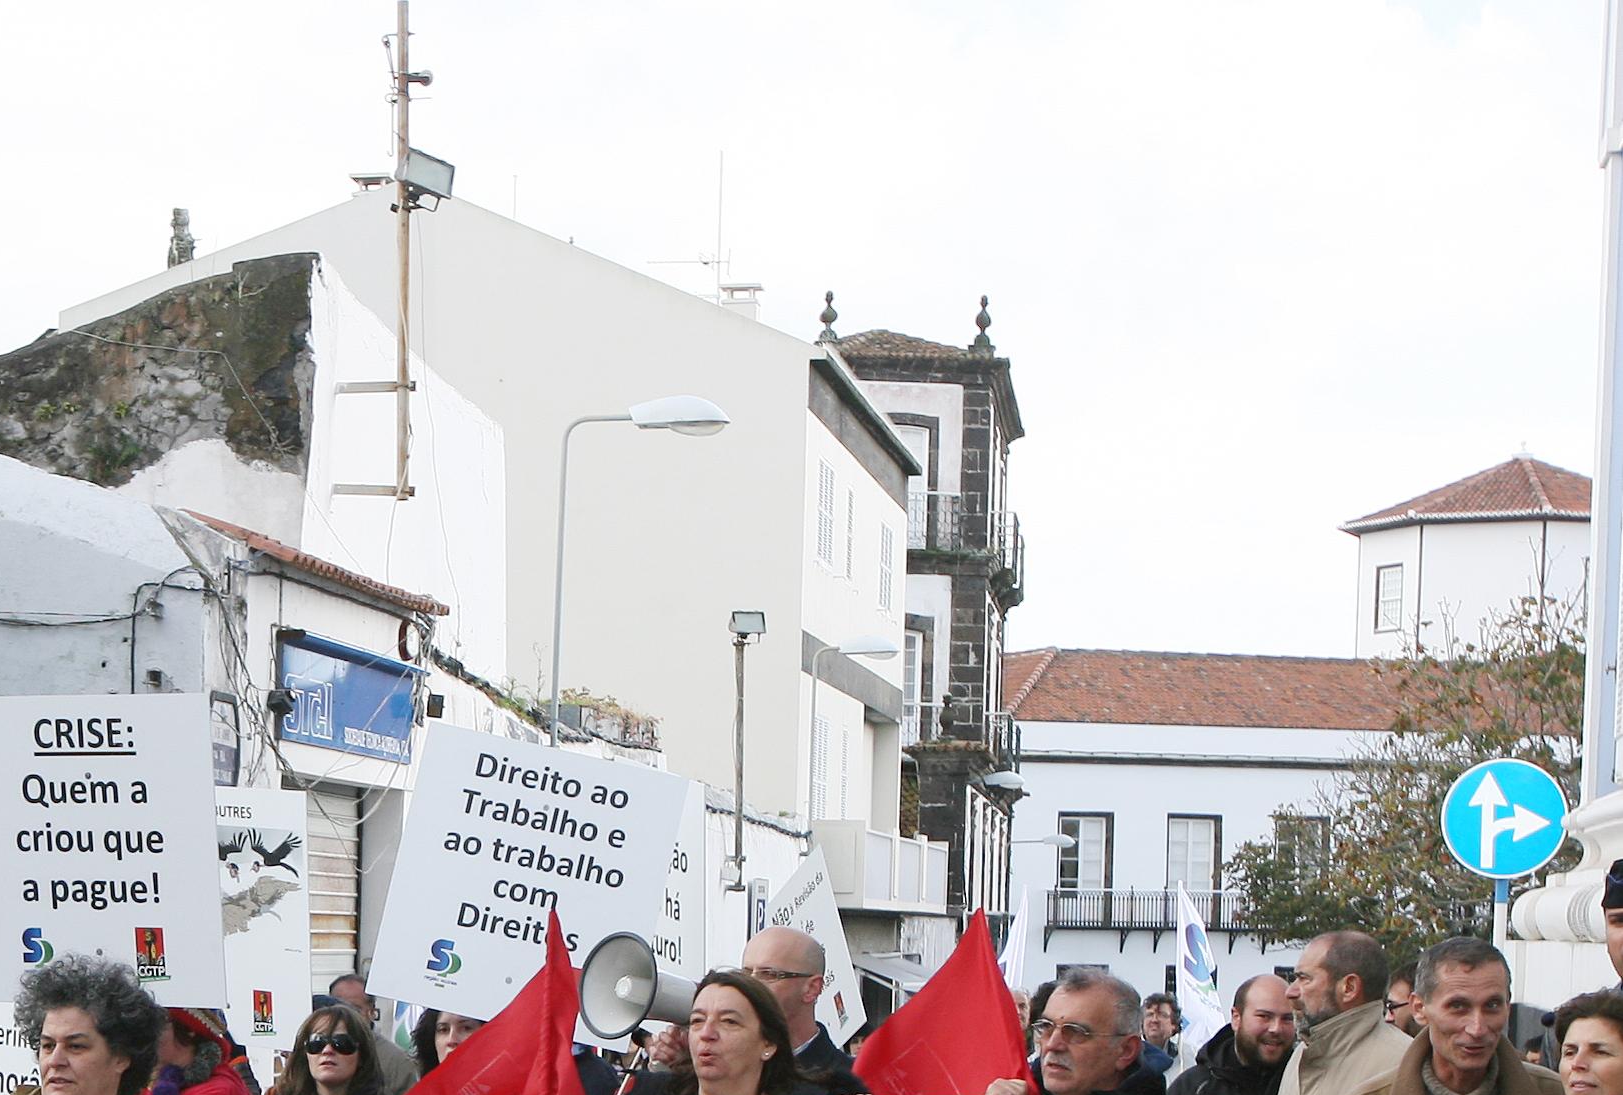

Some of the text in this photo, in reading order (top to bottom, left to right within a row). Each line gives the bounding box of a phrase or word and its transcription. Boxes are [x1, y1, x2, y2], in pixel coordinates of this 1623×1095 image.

[34, 718, 134, 748] CRISE:
[22, 774, 148, 808] Quem a
[475, 753, 629, 809] Direito ao
[216, 805, 252, 819] UTRES
[463, 789, 626, 848] Trabalho e
[17, 822, 164, 860] criou que
[443, 831, 624, 888] ao trabalho
[668, 843, 688, 874] ão
[23, 872, 160, 910] a pague!
[493, 879, 559, 911] com
[665, 887, 681, 921] há
[457, 902, 579, 952] Direits
[652, 935, 682, 966] uro!
[138, 965, 165, 977] CGTP
